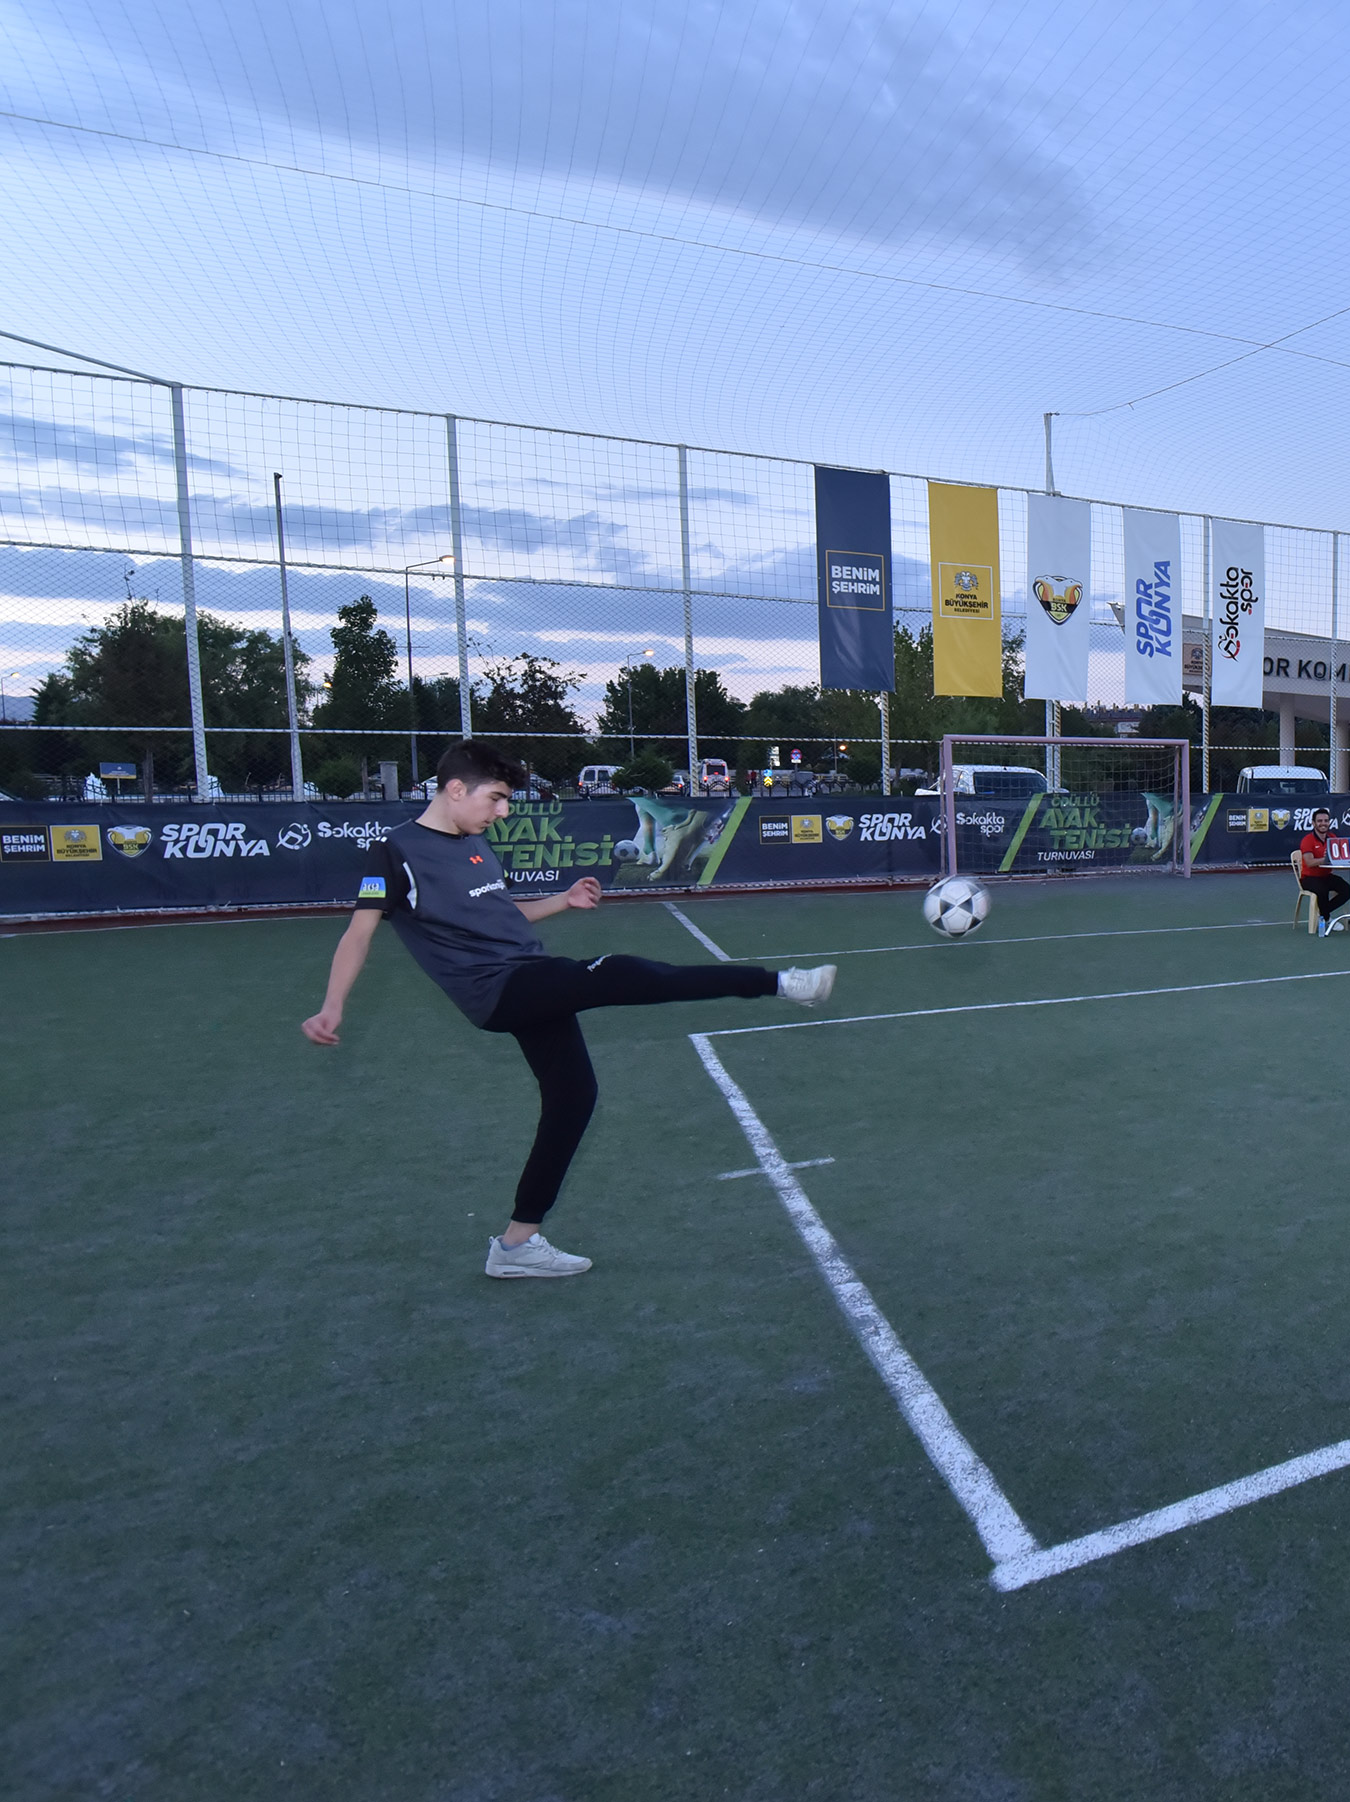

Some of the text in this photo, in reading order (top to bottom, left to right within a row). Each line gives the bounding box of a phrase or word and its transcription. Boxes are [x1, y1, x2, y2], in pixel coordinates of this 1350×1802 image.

[1050, 602, 1067, 612] BSK
[1148, 560, 1172, 658] KONYA
[1136, 578, 1153, 658] SPOR
[1263, 656, 1290, 678] OR
[508, 799, 562, 816] DÜLLÜ
[858, 812, 912, 829] SPOR
[956, 811, 1006, 826] Sokakta
[1039, 807, 1101, 828] AYAK
[160, 822, 247, 843] SPOR
[860, 823, 927, 841] KONYA
[980, 822, 1005, 839] spor
[1049, 823, 1132, 850] TENİSİ
[163, 835, 270, 859] KONYA
[1037, 850, 1095, 862] TURNUVASI
[510, 870, 560, 883] UVASI
